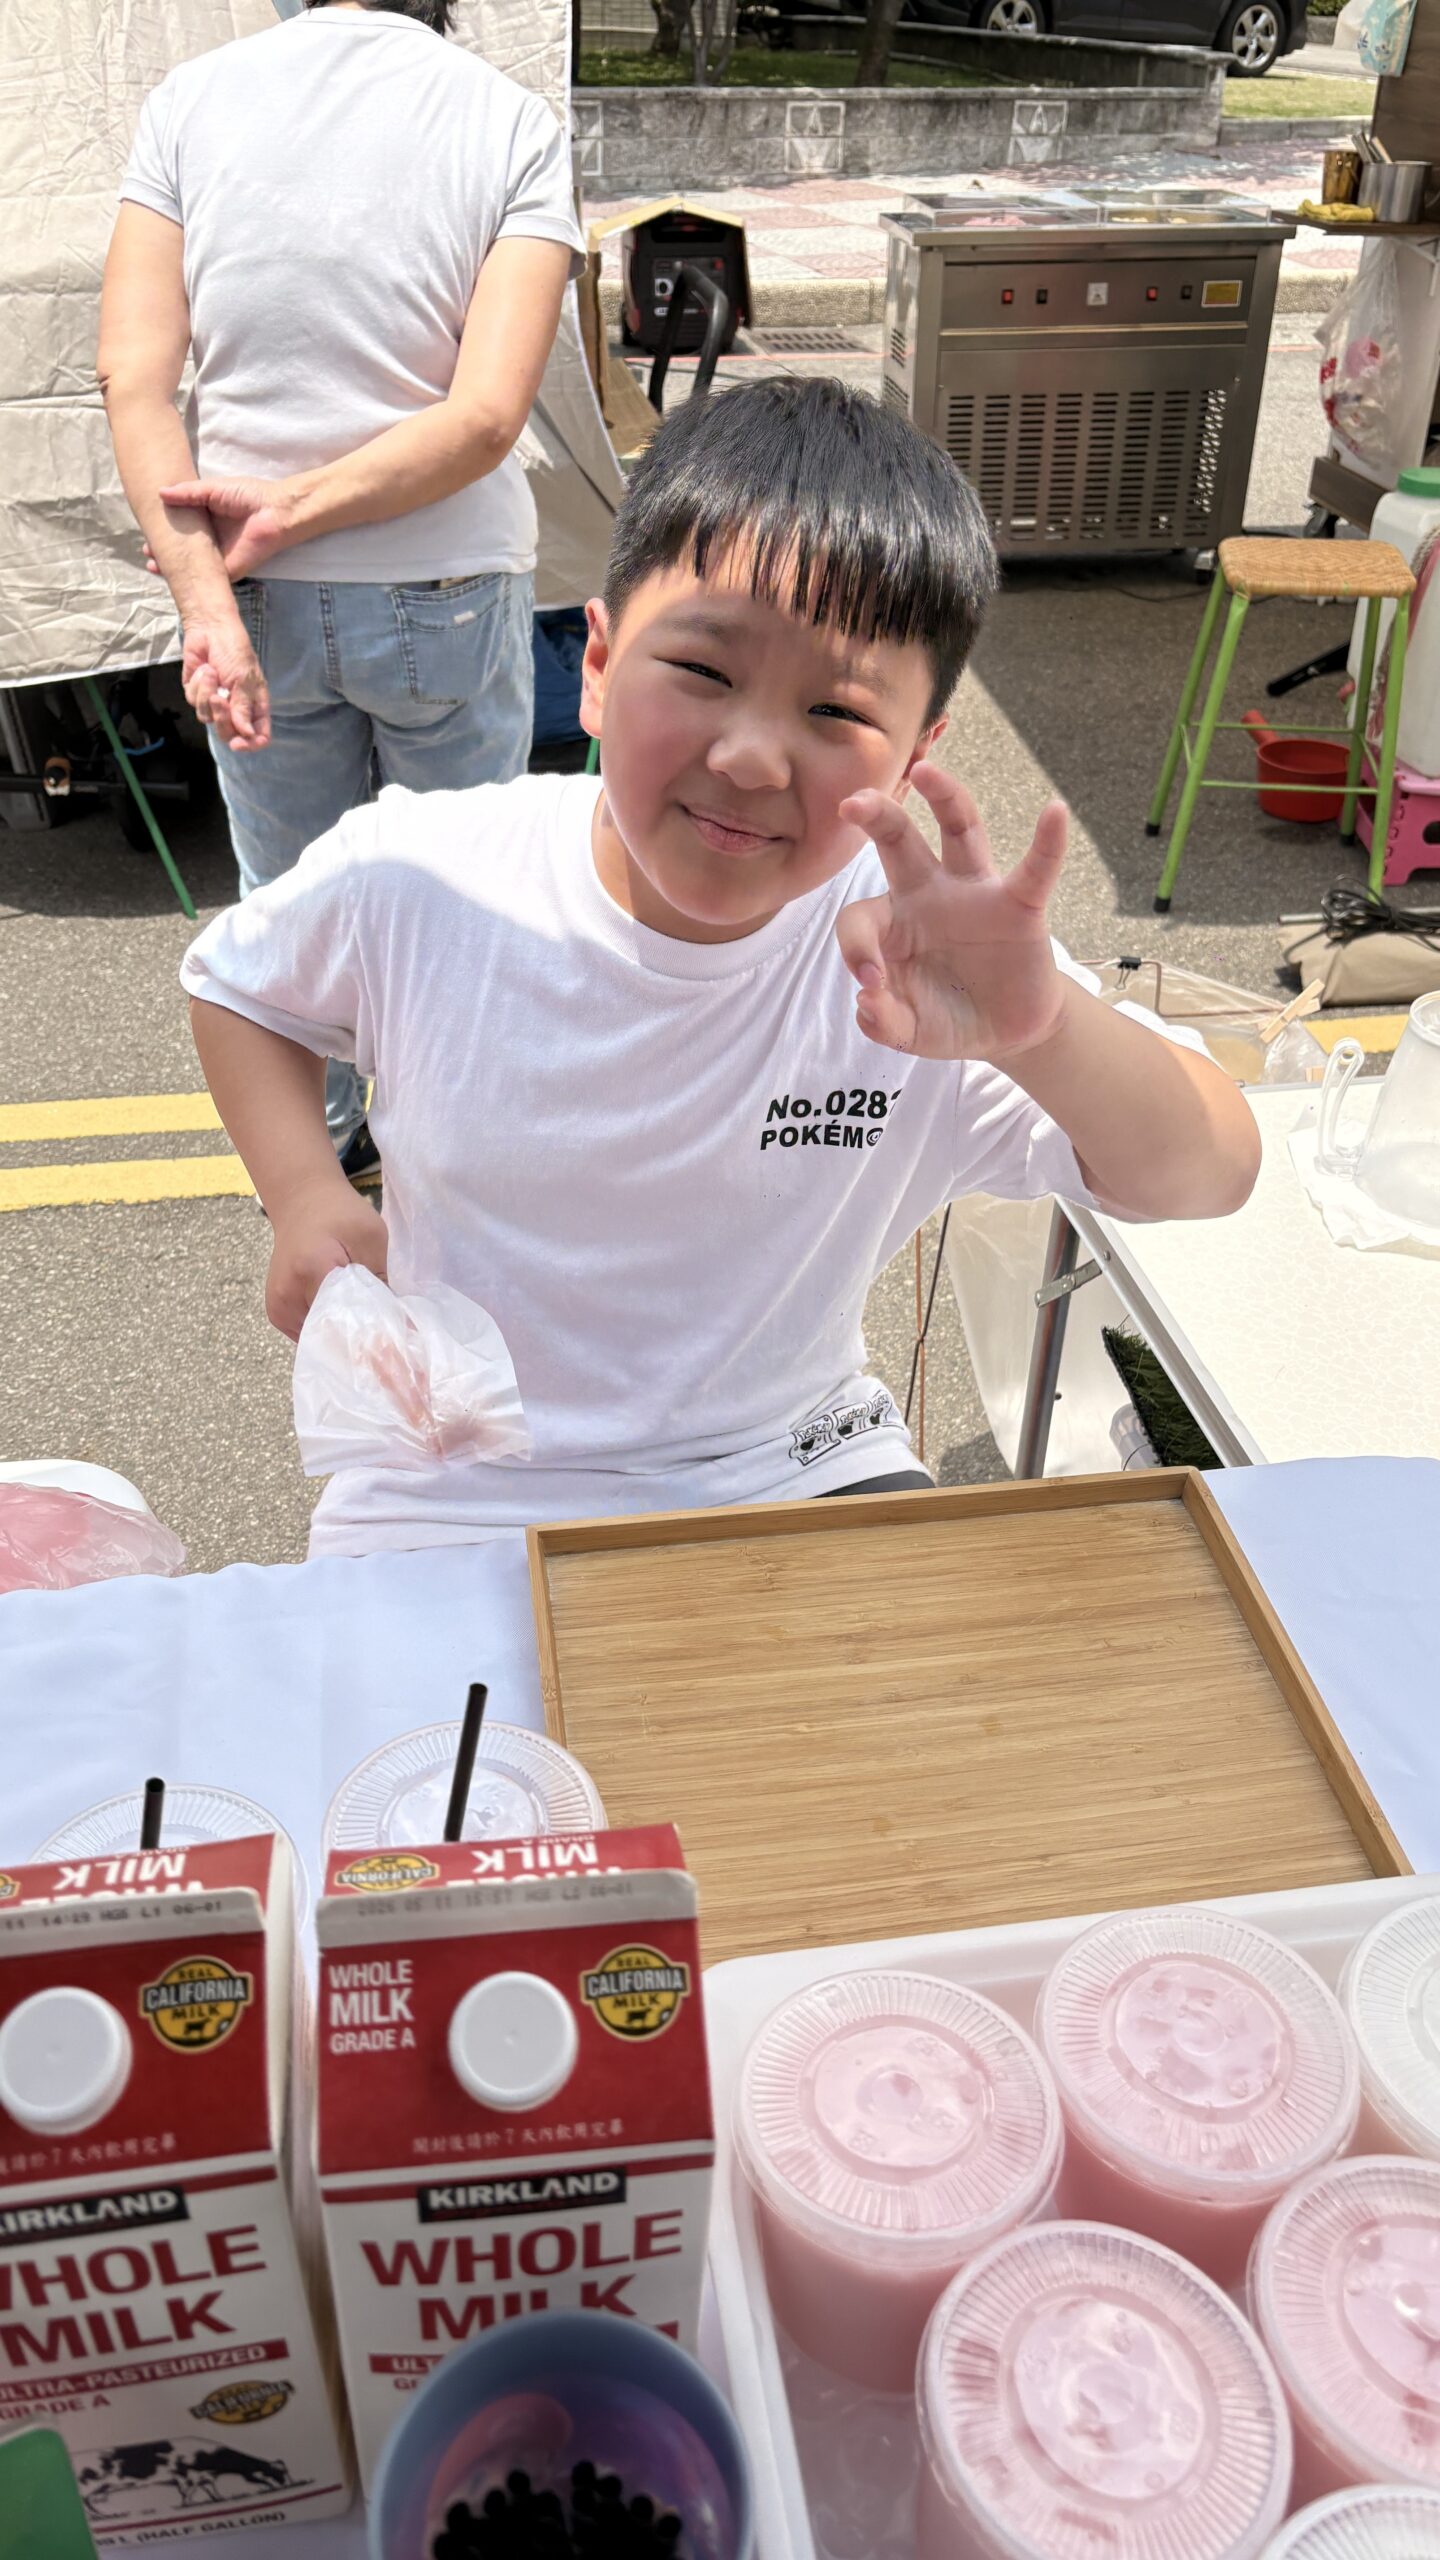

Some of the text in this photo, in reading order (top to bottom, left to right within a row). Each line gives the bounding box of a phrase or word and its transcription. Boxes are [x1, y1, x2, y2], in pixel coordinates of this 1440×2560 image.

[760, 1119, 884, 1150] POKÉMO
[52, 1852, 187, 1891] MILK
[471, 1841, 599, 1874] MILK
[341, 1866, 432, 1883] CALIFORNIA
[328, 1958, 415, 1989] WHOLE
[616, 1955, 651, 1968] REAL
[146, 1978, 246, 2010] CALIFORNIA
[587, 1968, 683, 1998] CALIFORNIA
[171, 2003, 220, 2019] MILK
[329, 1987, 415, 2028] MILK
[612, 1991, 659, 2009] MILK
[330, 2026, 417, 2056] GRADE A
[428, 2171, 620, 2210] KIRKLAND
[359, 2208, 684, 2287] WHOLE
[0, 2224, 267, 2311] HOLE
[0, 2289, 237, 2368] MILK
[0, 2344, 268, 2400] ULTRA-PASTEURIZED
[92, 2393, 111, 2409] A
